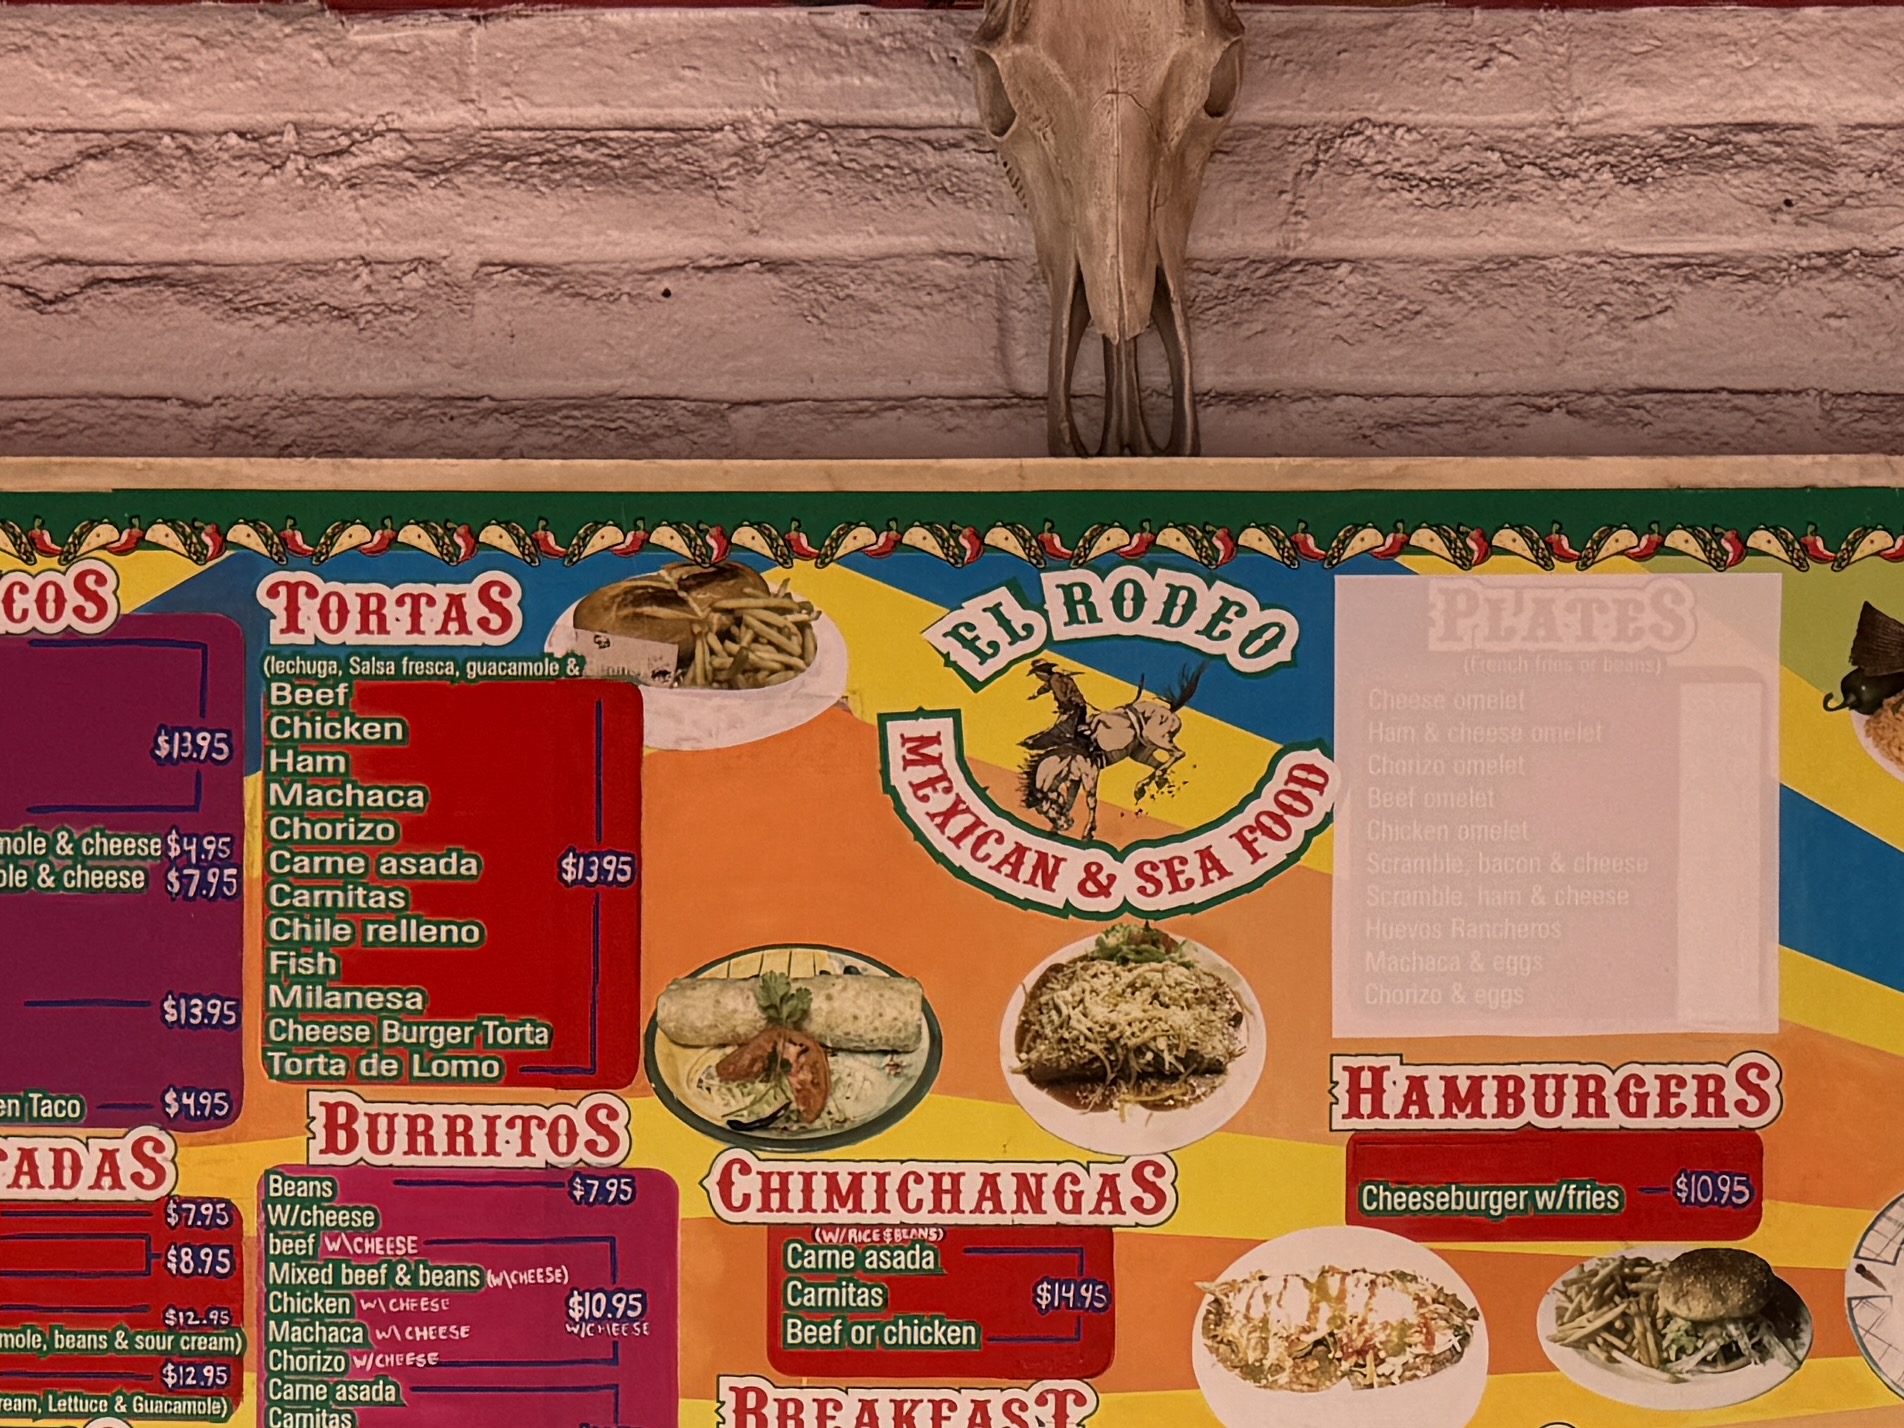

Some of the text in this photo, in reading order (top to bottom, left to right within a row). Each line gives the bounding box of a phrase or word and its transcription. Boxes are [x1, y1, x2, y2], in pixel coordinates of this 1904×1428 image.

[267, 581, 513, 635] TORTAS
[950, 576, 1288, 665] EL RODEO
[269, 786, 424, 808] Machaca
[899, 731, 1330, 899] MEXICAN & SEA FOOD
[562, 853, 631, 882] $13.95
[164, 997, 236, 1024] $13.95
[270, 1023, 549, 1048] Cheese Burger Torta
[1342, 1063, 1771, 1120] HAMBURGERS
[320, 1102, 621, 1158] BURRITOS
[717, 1159, 1168, 1215] CHIMICHANGAS
[1363, 1174, 1750, 1215] Cheeseburger w/fries $10.95
[787, 1281, 1106, 1311] Carnitas $14.95
[164, 1365, 227, 1388] $12.95
